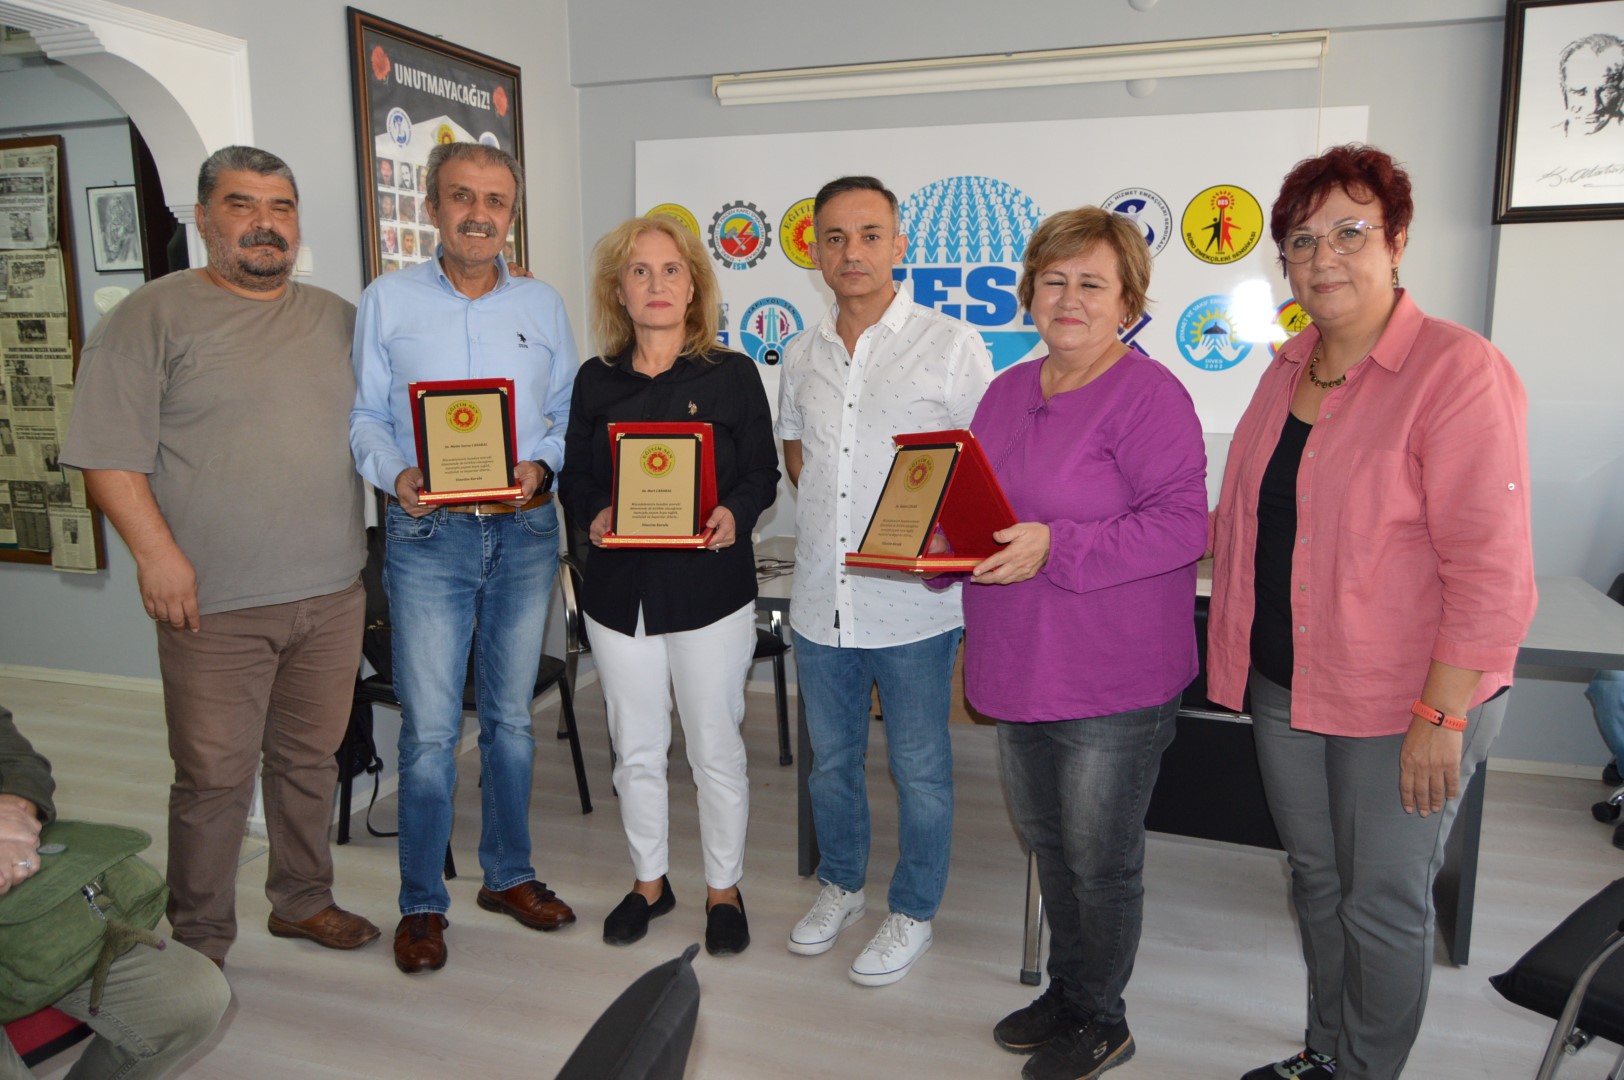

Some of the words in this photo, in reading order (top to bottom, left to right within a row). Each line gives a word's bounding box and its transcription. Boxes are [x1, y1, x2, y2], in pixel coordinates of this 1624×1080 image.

[394, 63, 490, 110] UNUTMAYACAĞIZ!
[1115, 190, 1137, 200] HİZMET
[1139, 191, 1168, 216] EMEKÇİLERİ
[1156, 218, 1169, 250] SENDİKASI
[1186, 232, 1196, 249] BÜRO
[1195, 249, 1231, 262] EMEKÇİLERİ
[1232, 231, 1256, 258] SENDİKASI
[748, 302, 762, 314] YAPI
[784, 303, 796, 314] SEN
[448, 402, 467, 415] EĞİTİM
[469, 405, 478, 414] SEN
[643, 447, 662, 458] EĞİTİM
[664, 449, 673, 458] SEN
